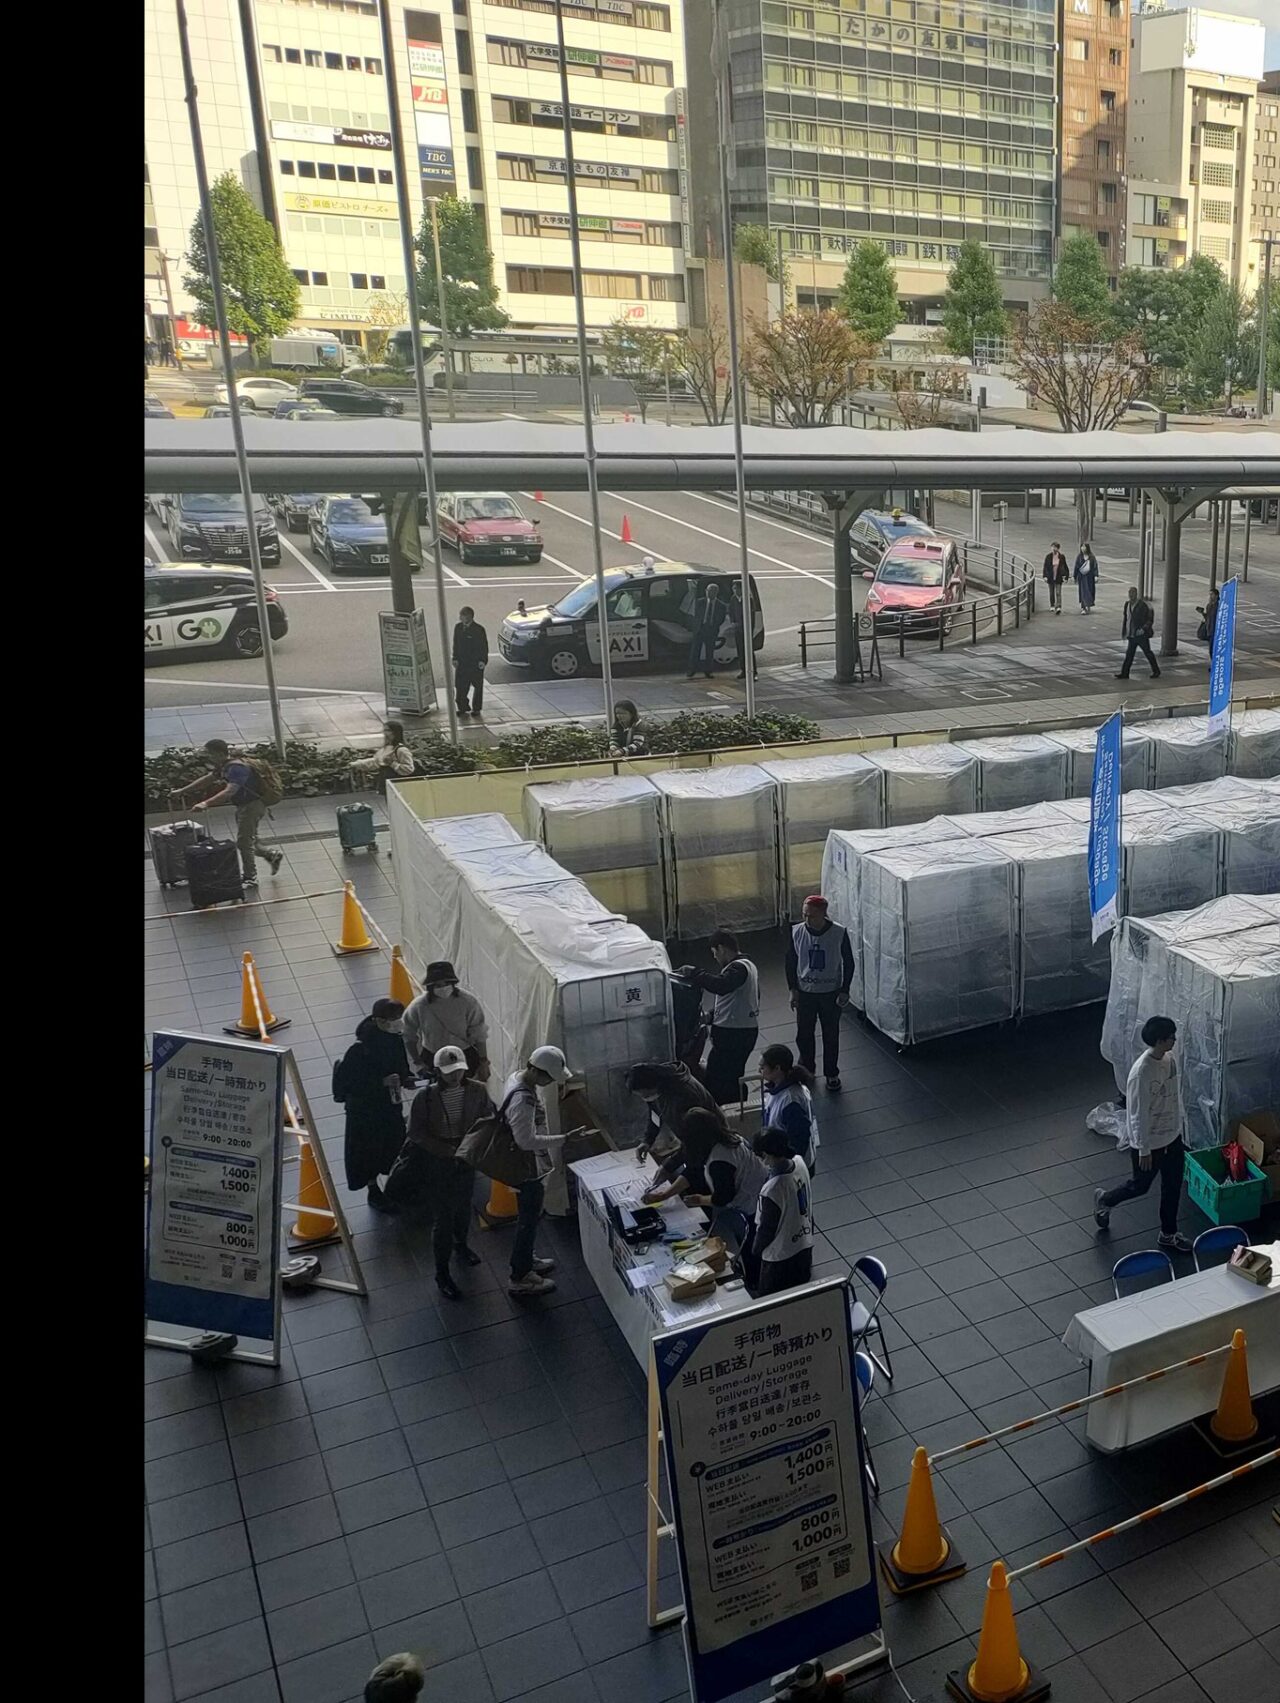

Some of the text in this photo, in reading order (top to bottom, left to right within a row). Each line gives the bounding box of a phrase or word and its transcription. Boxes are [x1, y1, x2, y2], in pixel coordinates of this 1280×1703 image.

[418, 86, 442, 101] JTB
[540, 104, 631, 123] 英会話イーオン
[426, 152, 447, 162] TBC
[625, 987, 643, 1004] 黄
[201, 1056, 233, 1073] 手荷物
[166, 1068, 267, 1093] 当日配送/一時預かり
[734, 1324, 781, 1349] 手荷物
[682, 1327, 833, 1388] 当日配送/一時預かり
[708, 1355, 813, 1396] Same-day Luggage
